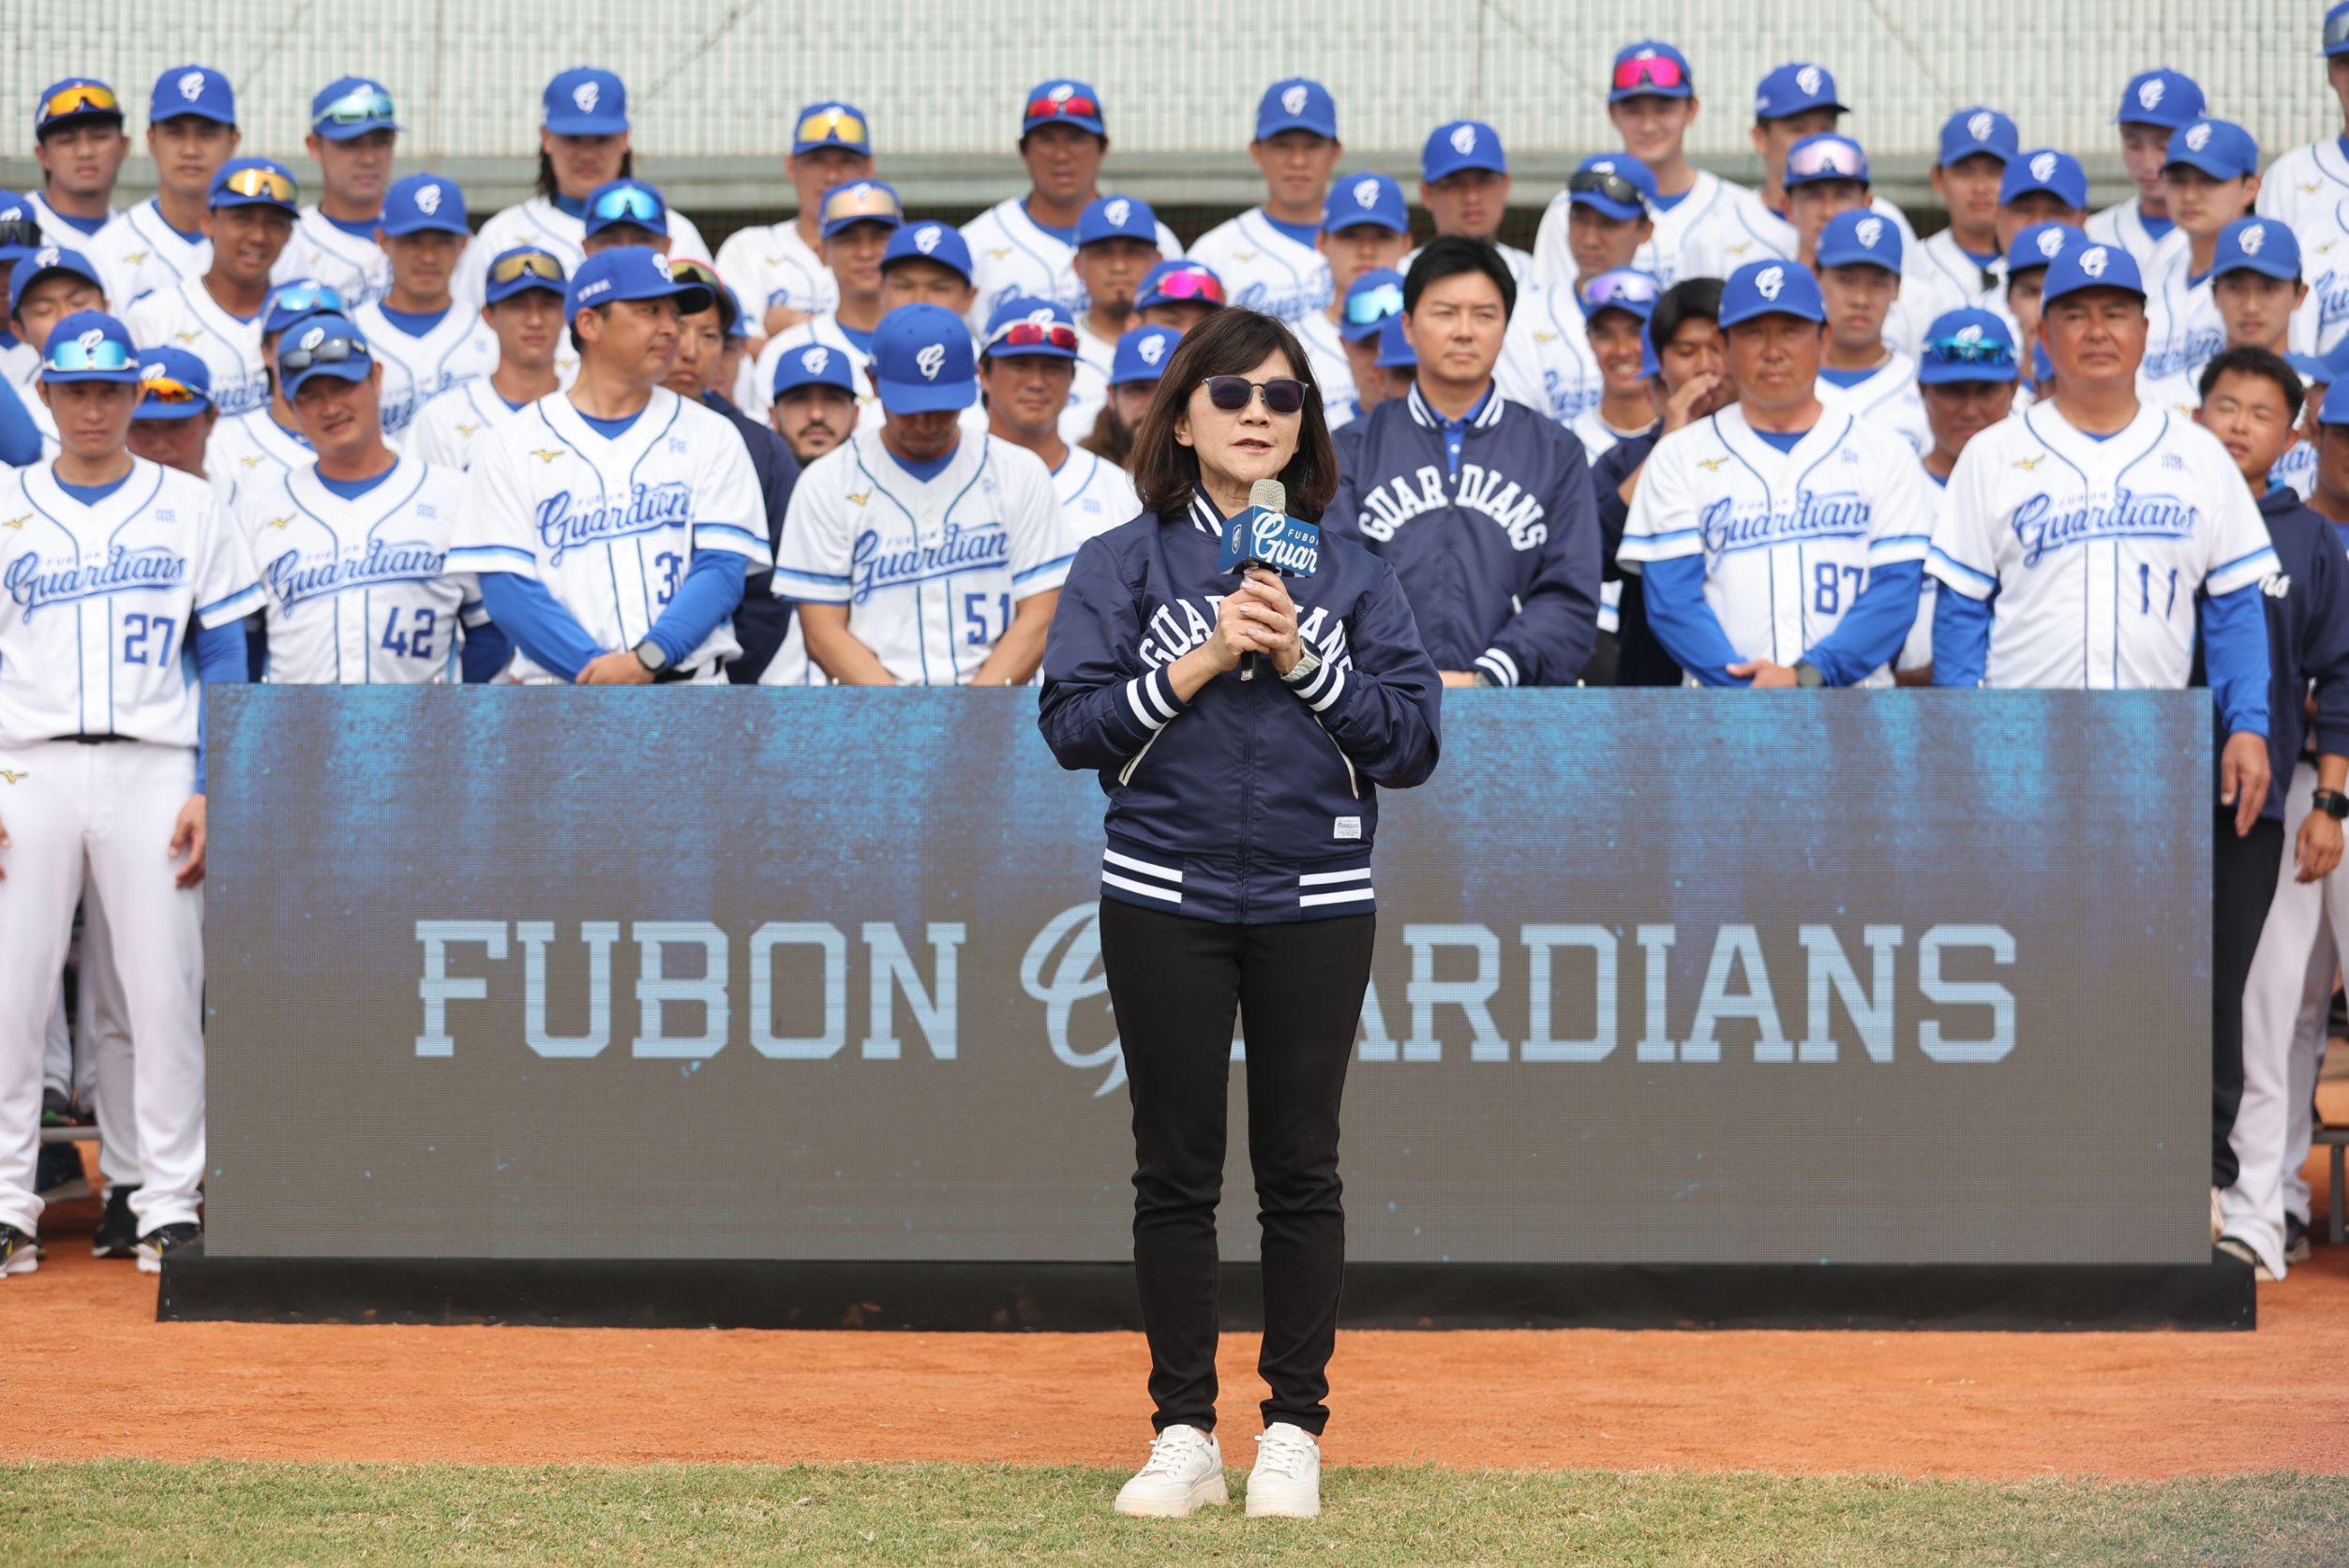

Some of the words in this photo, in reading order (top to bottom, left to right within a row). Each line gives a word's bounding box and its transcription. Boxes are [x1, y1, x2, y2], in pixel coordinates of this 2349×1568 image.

[536, 482, 694, 567] Guardian
[1358, 463, 1549, 551] GUARDIANS
[2012, 485, 2198, 568] Guardians
[4, 545, 189, 624] Guardians
[269, 538, 448, 620] Guardians
[1816, 562, 1863, 615] 87
[2139, 562, 2177, 620] 11
[124, 613, 176, 667] 27
[381, 606, 436, 659] 42
[965, 593, 1010, 645] 51
[415, 919, 966, 1060] FUBON
[1019, 901, 2017, 1098] GRDIANS
